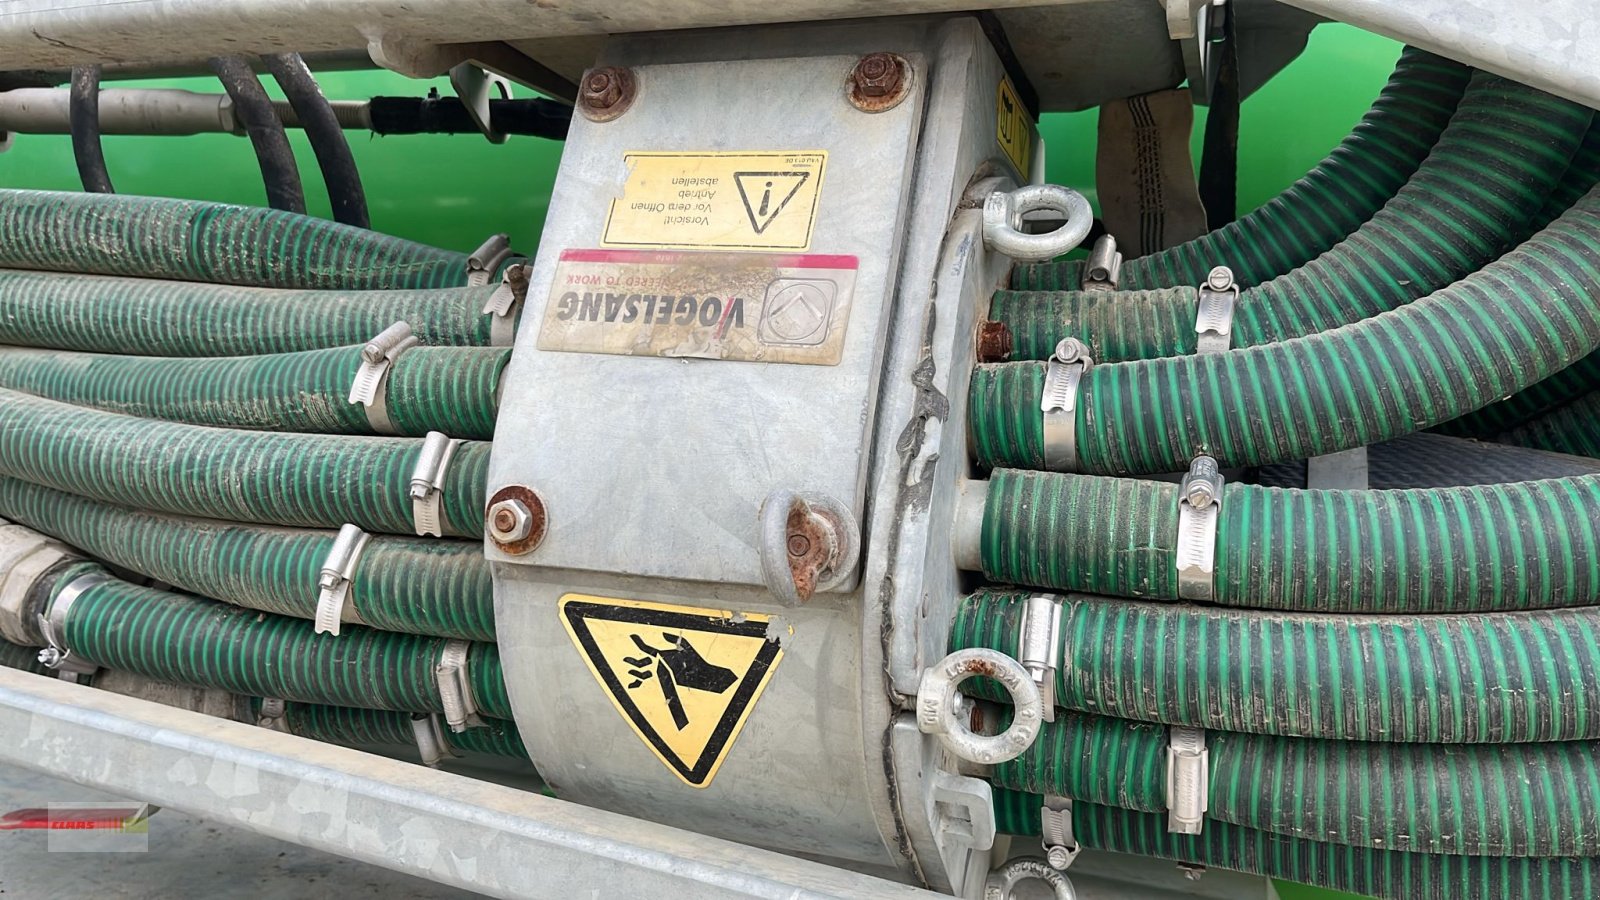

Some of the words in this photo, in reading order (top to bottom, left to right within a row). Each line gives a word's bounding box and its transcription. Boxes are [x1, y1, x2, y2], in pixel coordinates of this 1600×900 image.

[671, 177, 718, 187] abstellen
[677, 190, 716, 200] Antrieb
[631, 202, 666, 213] Öffnen
[695, 202, 713, 213] Vor
[663, 215, 709, 226] Vorsicht!
[566, 274, 602, 286] WORK
[606, 276, 621, 286] TO
[557, 291, 744, 340] VOGELSANG
